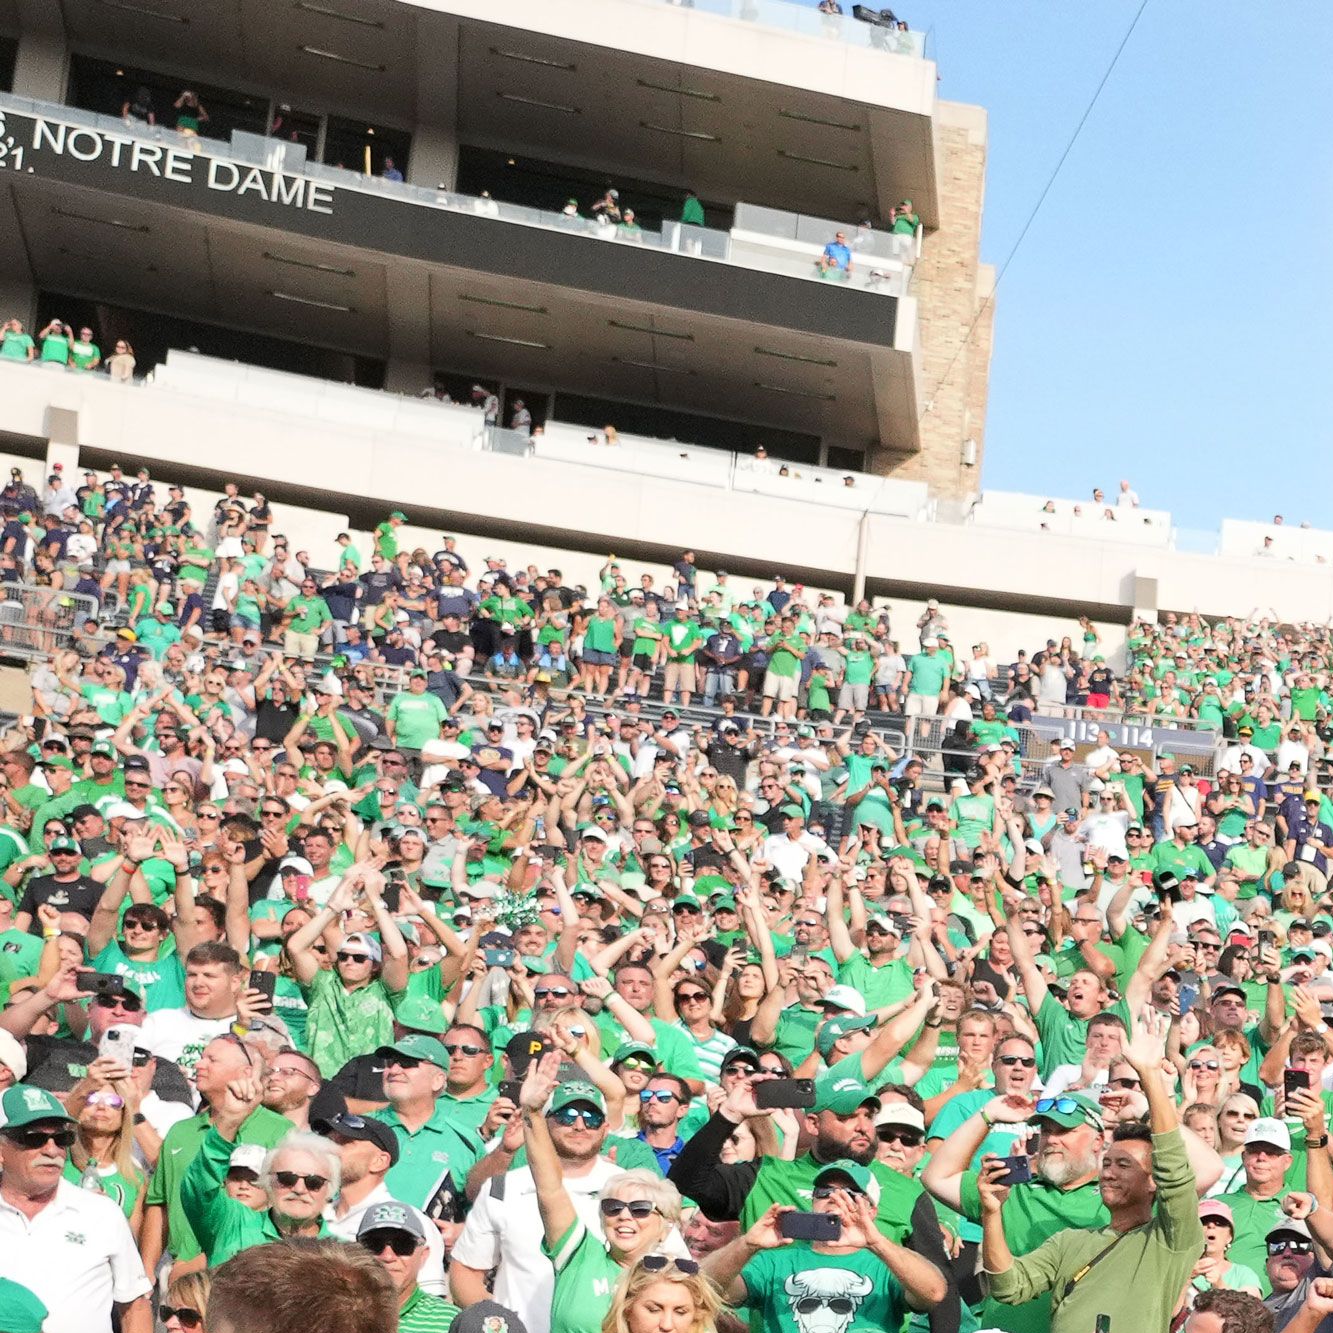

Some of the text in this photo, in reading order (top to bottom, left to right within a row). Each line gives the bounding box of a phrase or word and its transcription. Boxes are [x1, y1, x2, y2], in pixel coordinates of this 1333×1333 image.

[33, 119, 195, 184] NOTRE
[207, 158, 336, 214] DAME
[1121, 727, 1153, 747] 114
[528, 1040, 543, 1056] P
